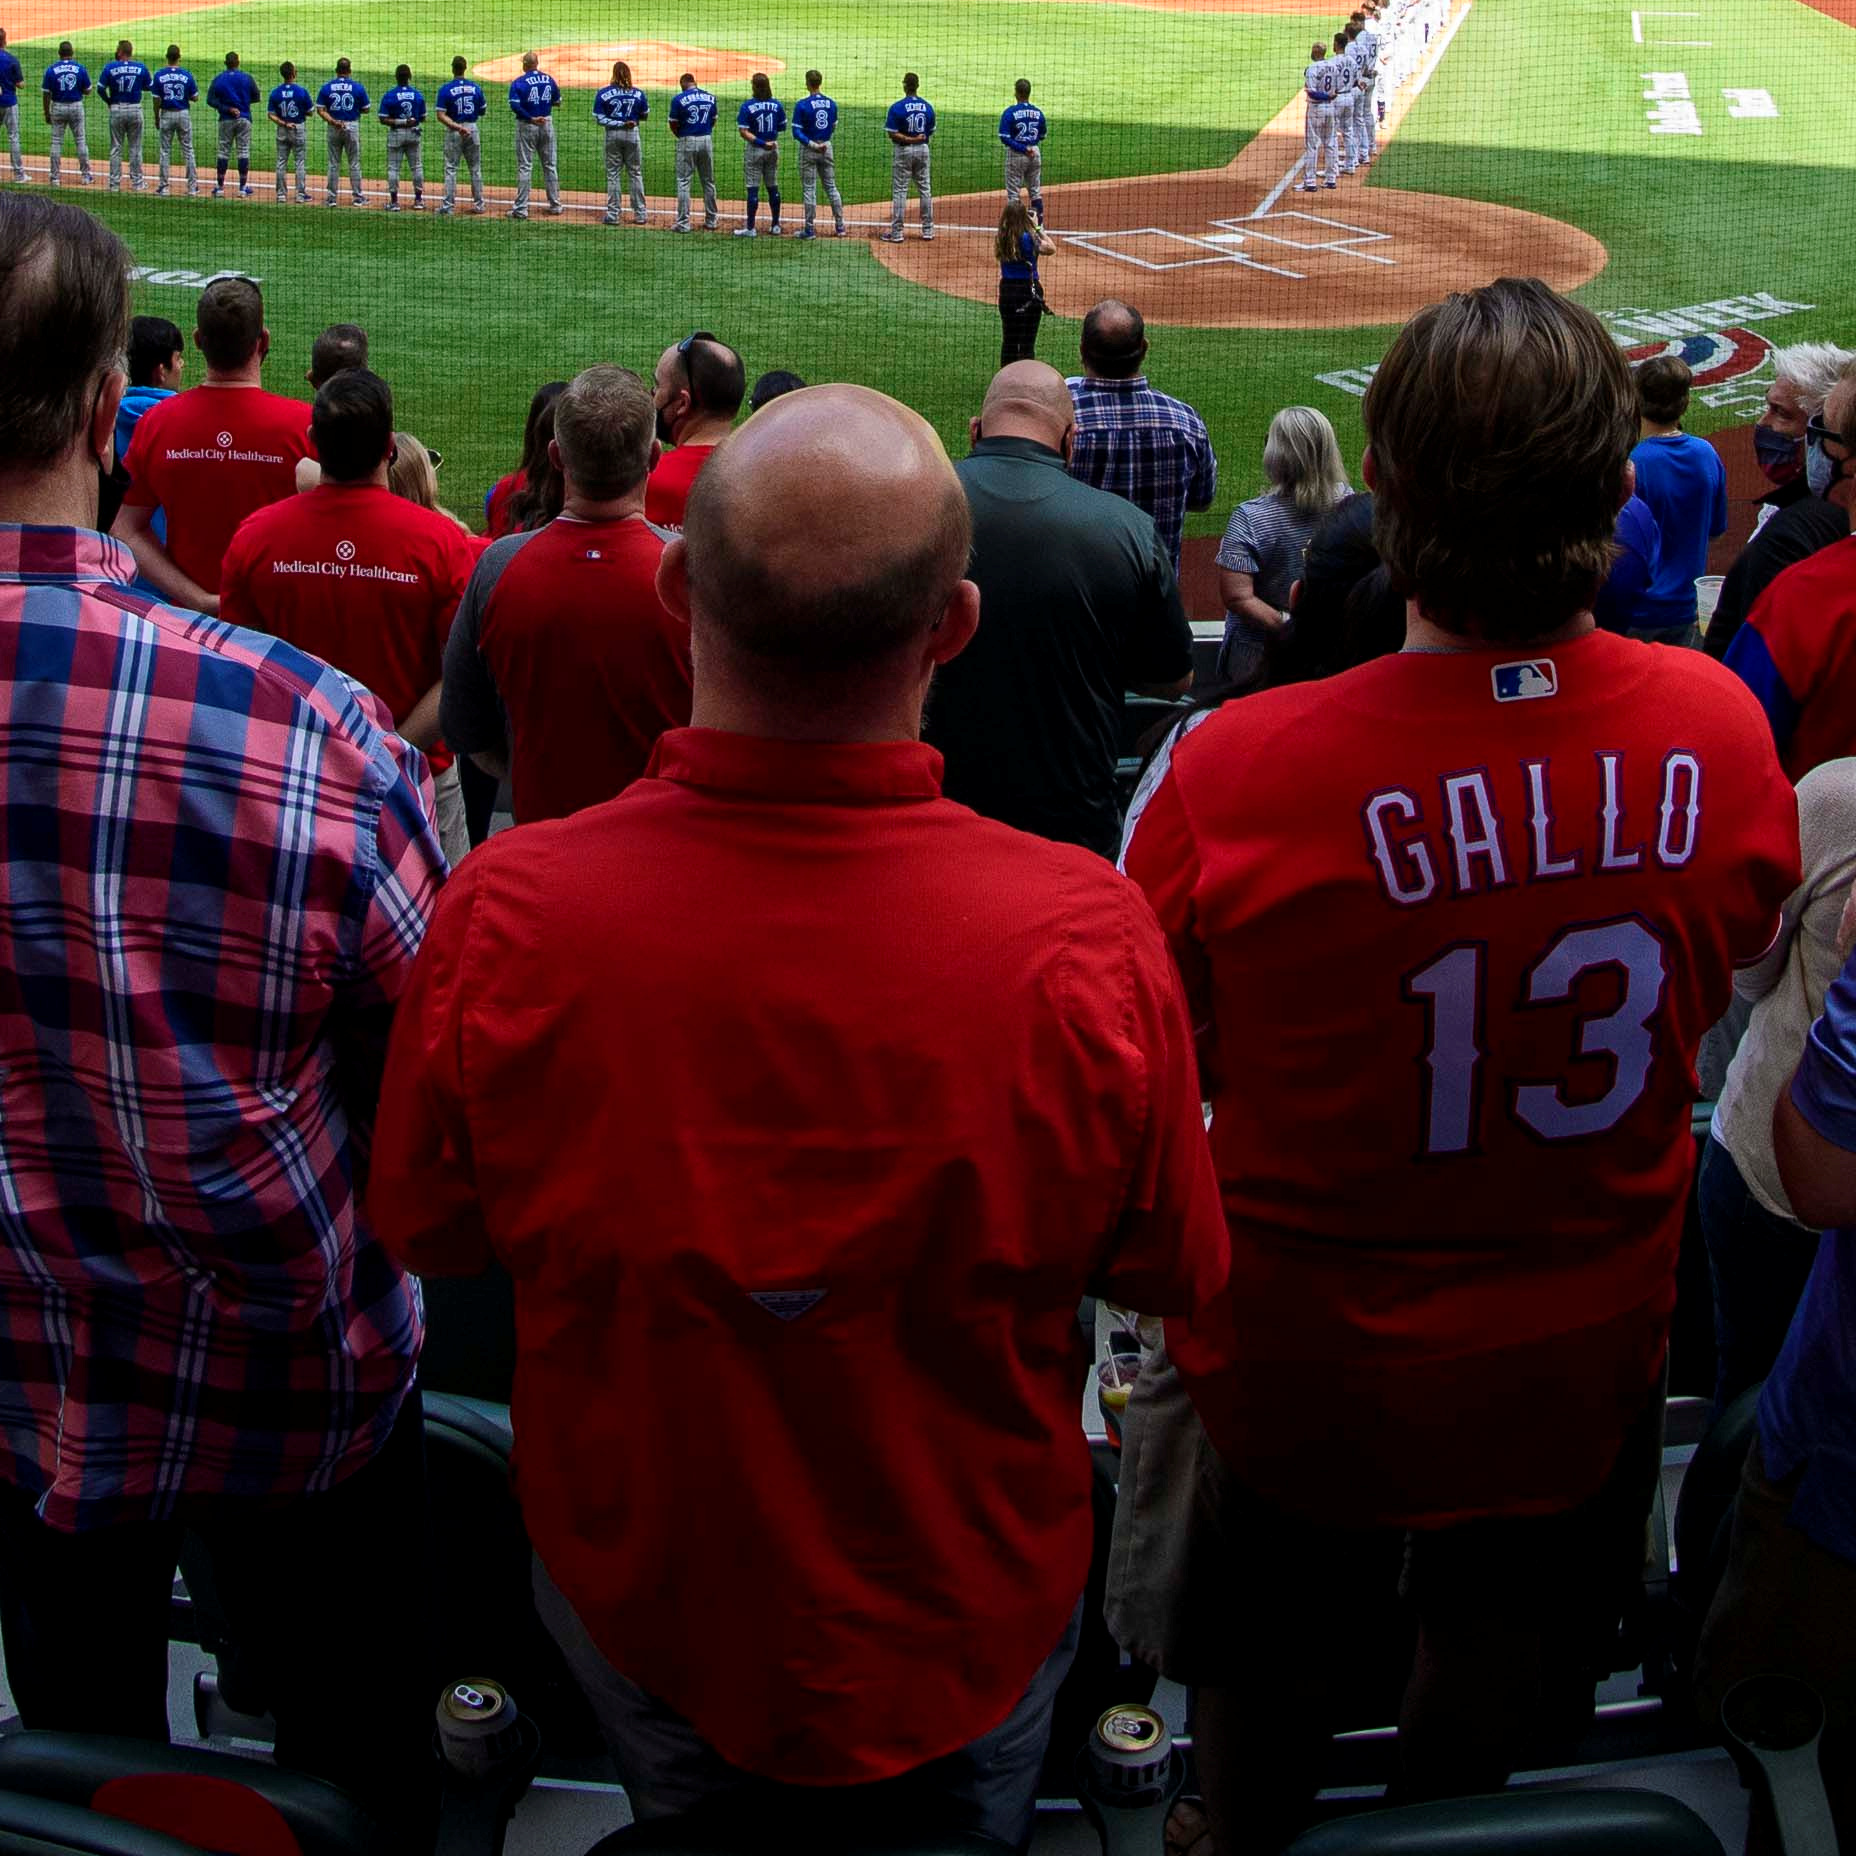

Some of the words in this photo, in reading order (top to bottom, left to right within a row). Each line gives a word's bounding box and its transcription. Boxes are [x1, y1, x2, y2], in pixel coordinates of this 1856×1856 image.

[59, 74, 78, 92] 19
[116, 74, 137, 93] 17
[163, 82, 186, 102] 53
[328, 92, 356, 111] 20
[527, 85, 553, 105] 44
[278, 100, 300, 118] 16
[400, 101, 414, 119] 3
[453, 96, 476, 115] 15
[609, 98, 635, 117] 27
[686, 103, 711, 124] 37
[755, 112, 774, 132] 11
[814, 109, 829, 129] 8
[905, 112, 926, 133] 10
[1014, 120, 1040, 141] 25
[165, 448, 205, 461] Medical
[205, 448, 227, 463] City
[228, 449, 285, 464] Healthcare
[273, 559, 321, 575] Medical
[321, 561, 348, 579] City
[350, 562, 420, 585] Healthcare
[1361, 747, 1705, 910] GALLO
[1401, 911, 1672, 1160] 13
